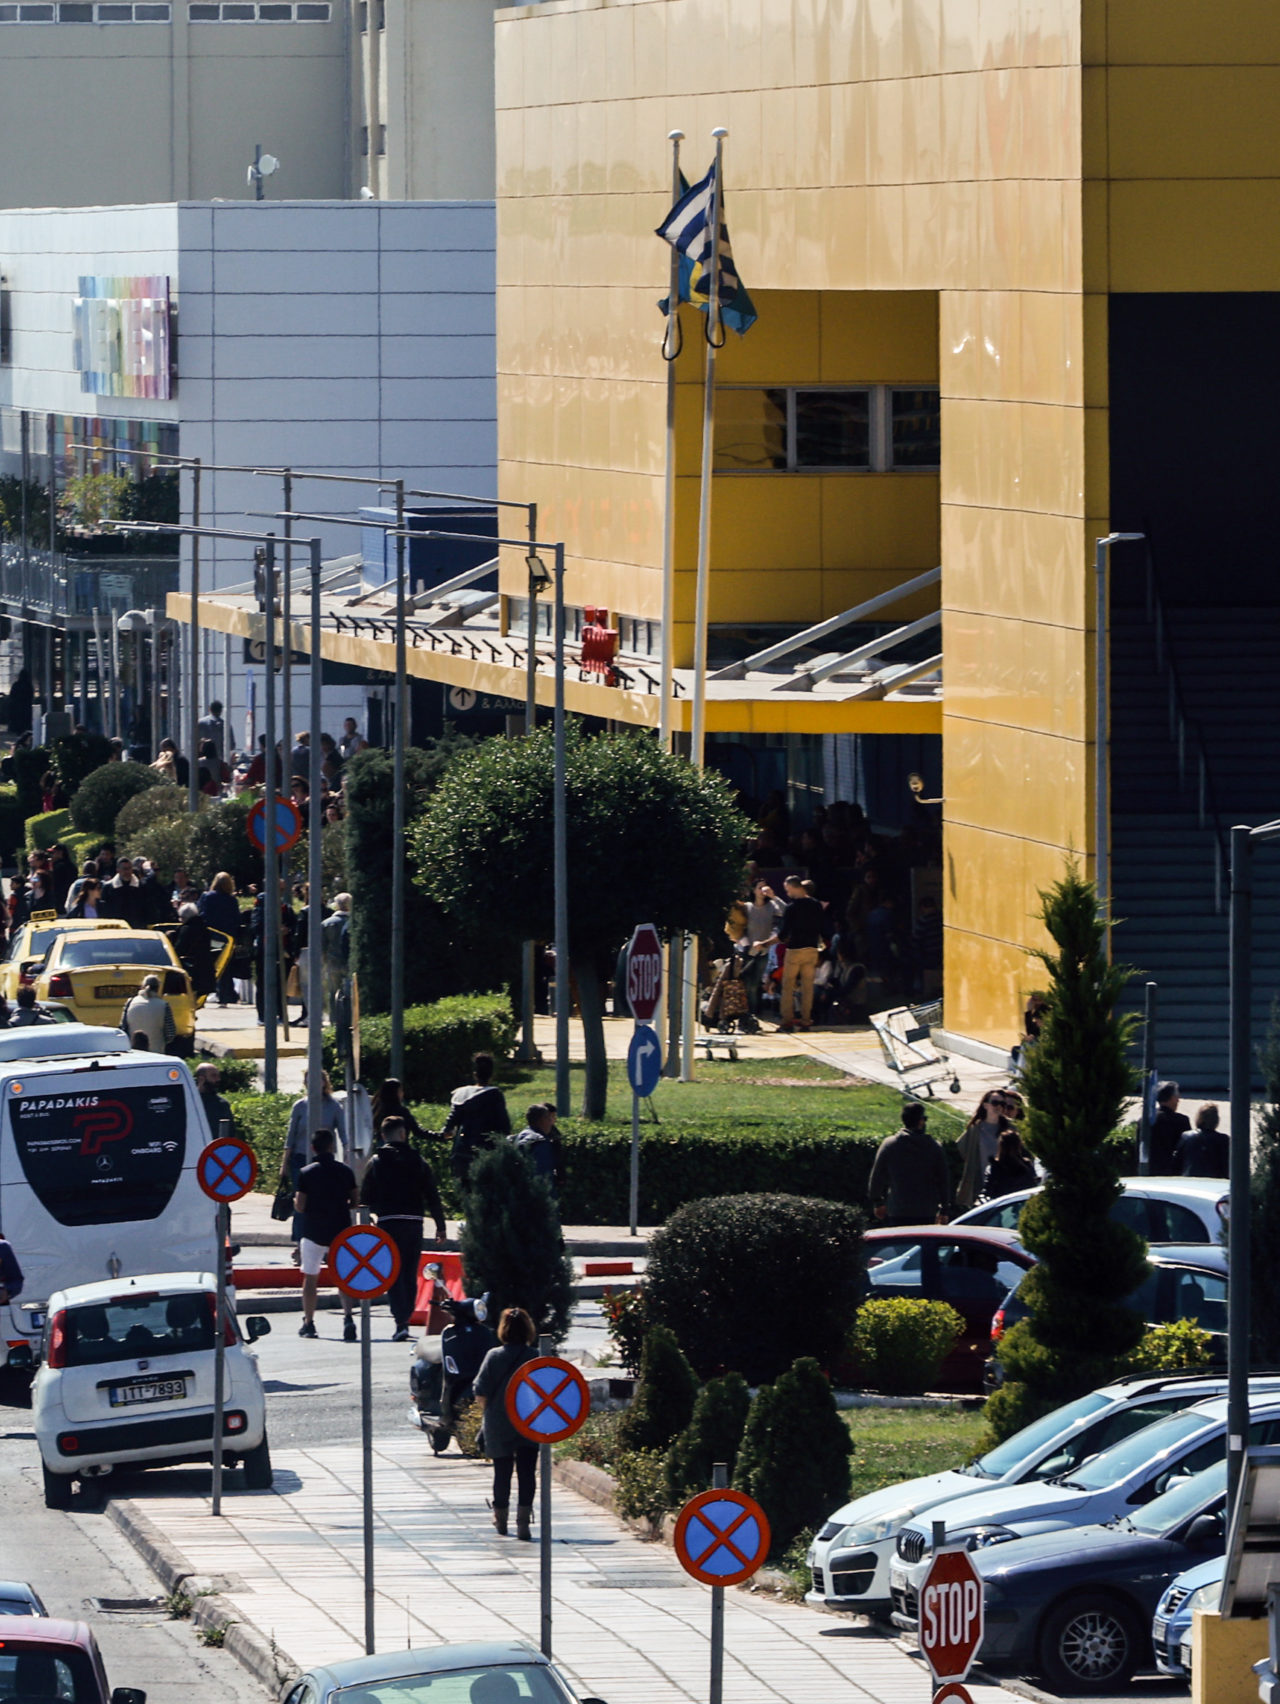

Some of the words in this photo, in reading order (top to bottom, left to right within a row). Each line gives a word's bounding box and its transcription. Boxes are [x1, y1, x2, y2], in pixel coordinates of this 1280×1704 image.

[629, 953, 660, 1002] STOP
[19, 1096, 99, 1112] PAPADAKIS
[924, 1579, 978, 1649] STOP
